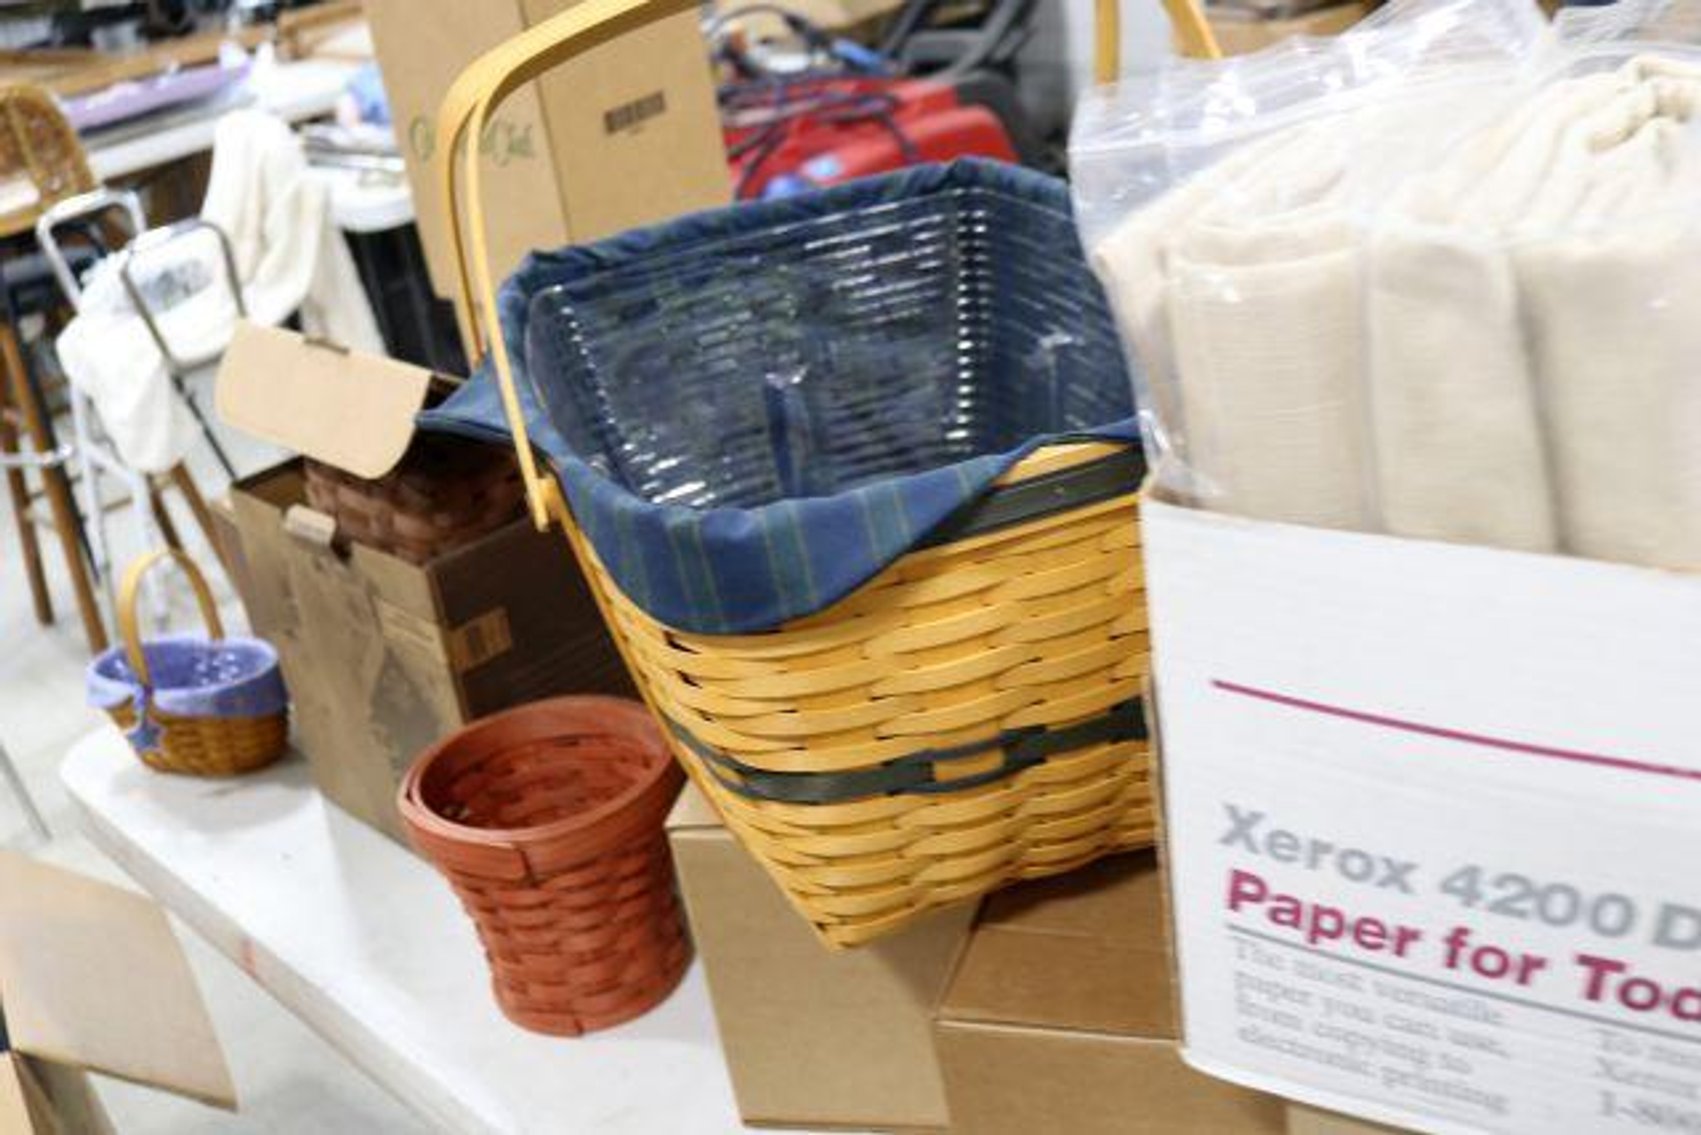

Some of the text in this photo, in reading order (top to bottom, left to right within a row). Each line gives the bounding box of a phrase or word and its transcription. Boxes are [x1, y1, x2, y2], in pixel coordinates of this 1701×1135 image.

[1220, 803, 1418, 894] Xerox
[1440, 864, 1637, 939] 4200
[1226, 866, 1421, 958] Paper
[1440, 925, 1547, 986] for
